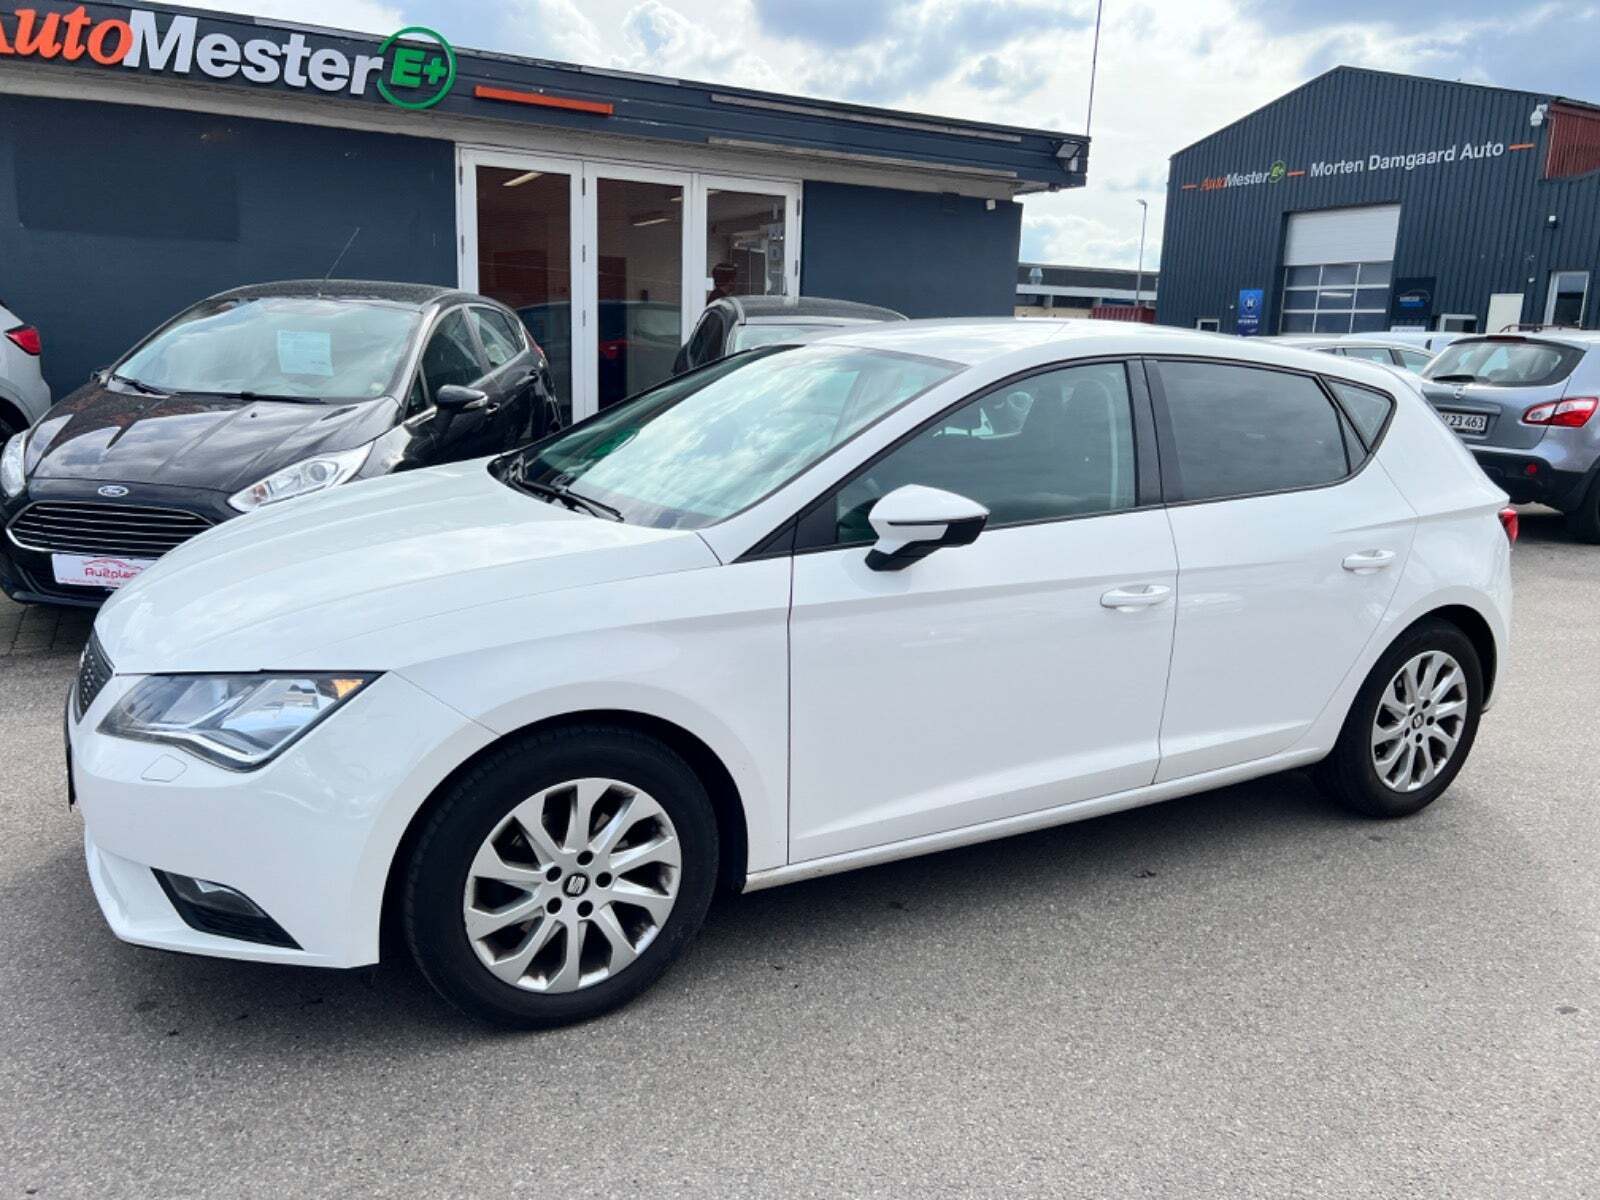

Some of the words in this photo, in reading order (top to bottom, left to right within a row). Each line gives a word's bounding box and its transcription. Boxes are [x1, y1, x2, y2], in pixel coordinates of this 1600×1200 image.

[1310, 160, 1364, 177] Morten
[1368, 145, 1456, 171] Damgaard
[1459, 141, 1504, 161] Auto
[1200, 171, 1270, 191] AutoMester
